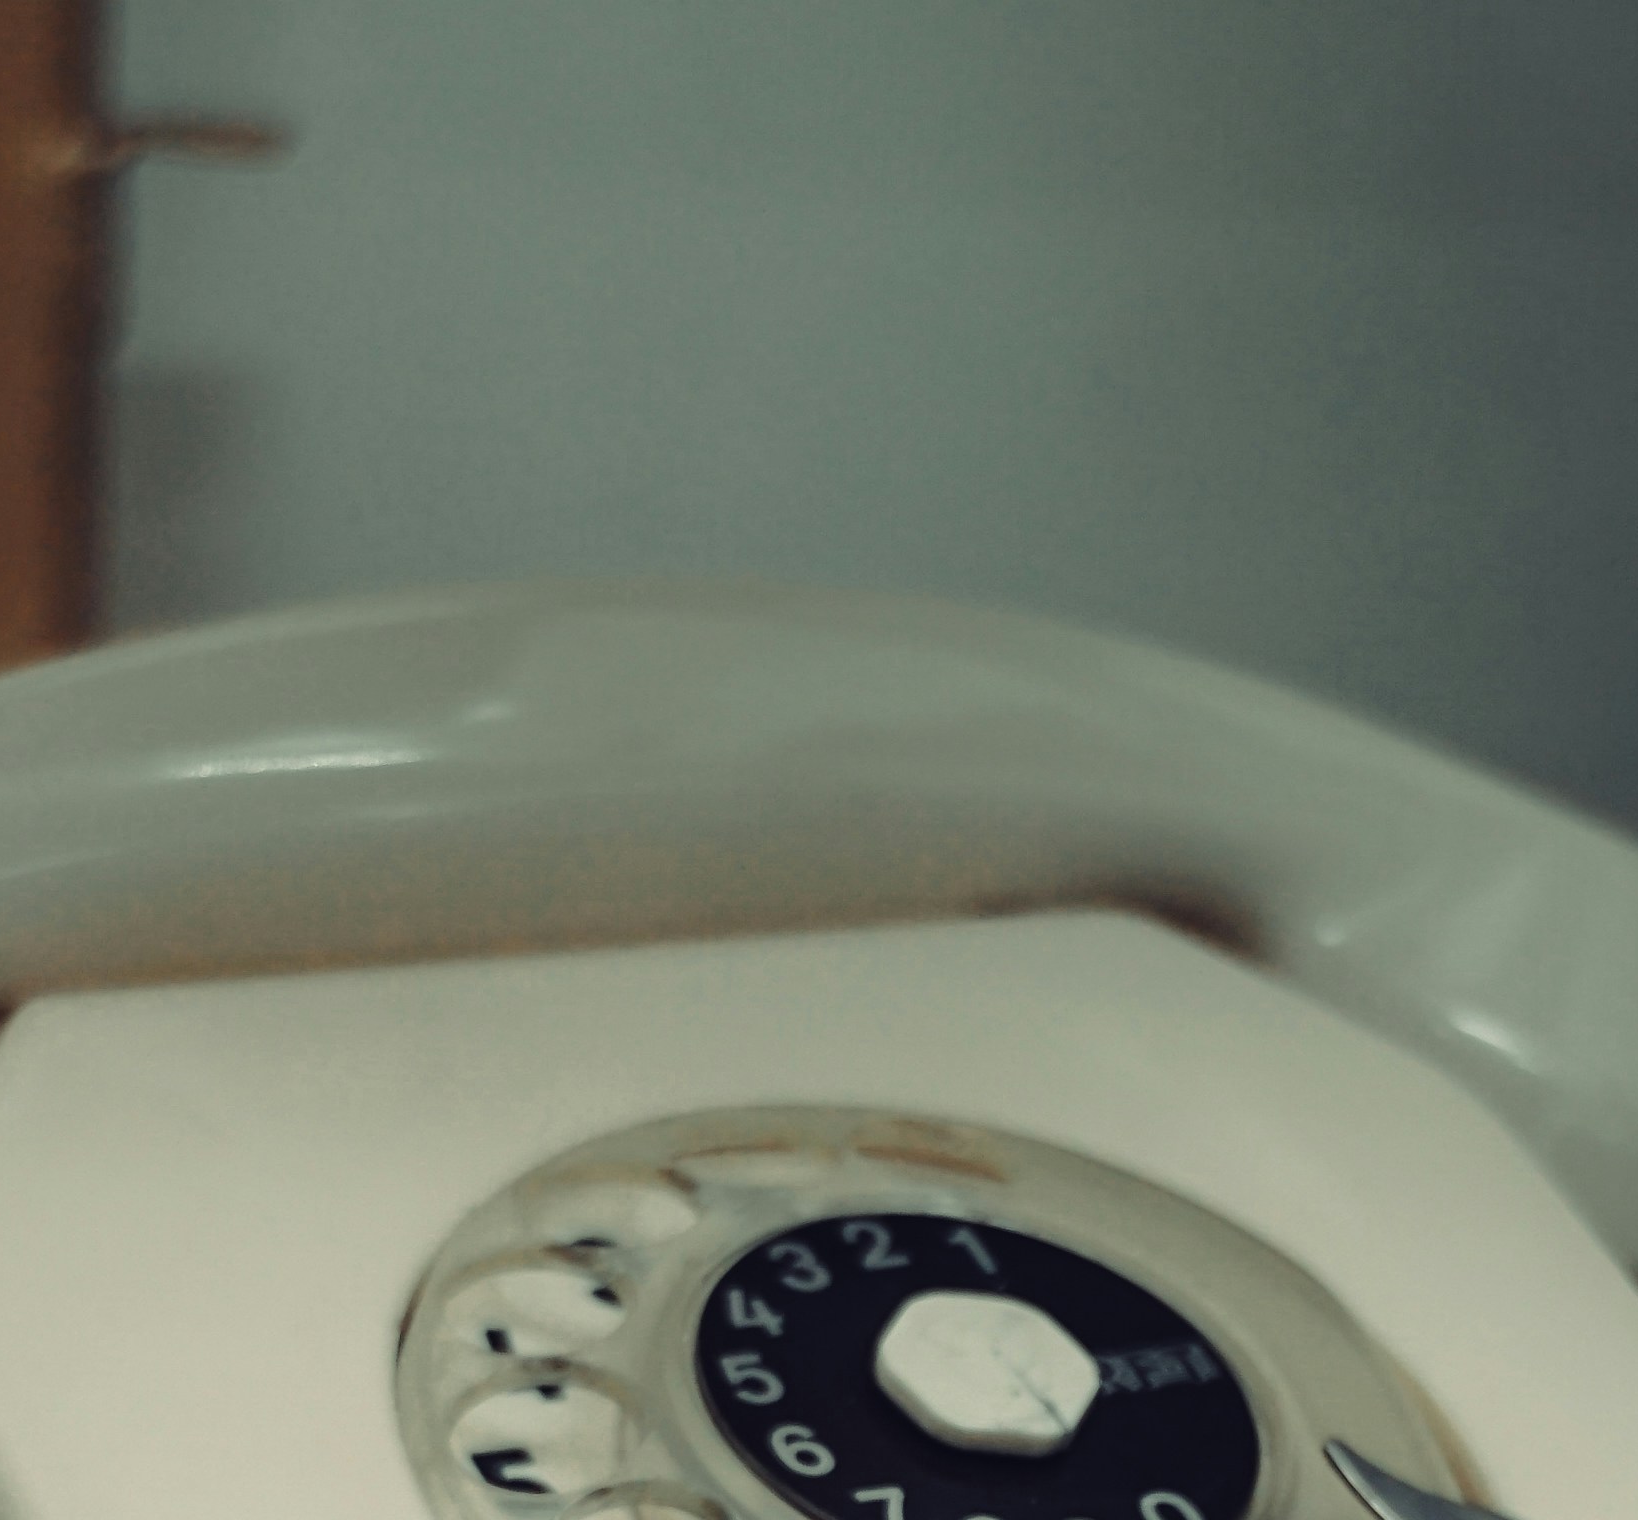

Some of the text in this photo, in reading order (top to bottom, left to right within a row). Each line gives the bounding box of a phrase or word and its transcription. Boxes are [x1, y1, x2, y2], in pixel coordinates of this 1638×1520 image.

[768, 1242, 831, 1293] 3
[841, 1220, 910, 1270] 2
[948, 1226, 997, 1275] 1
[727, 1288, 783, 1336] 4
[719, 1352, 785, 1405] 5
[770, 1424, 836, 1477] 6
